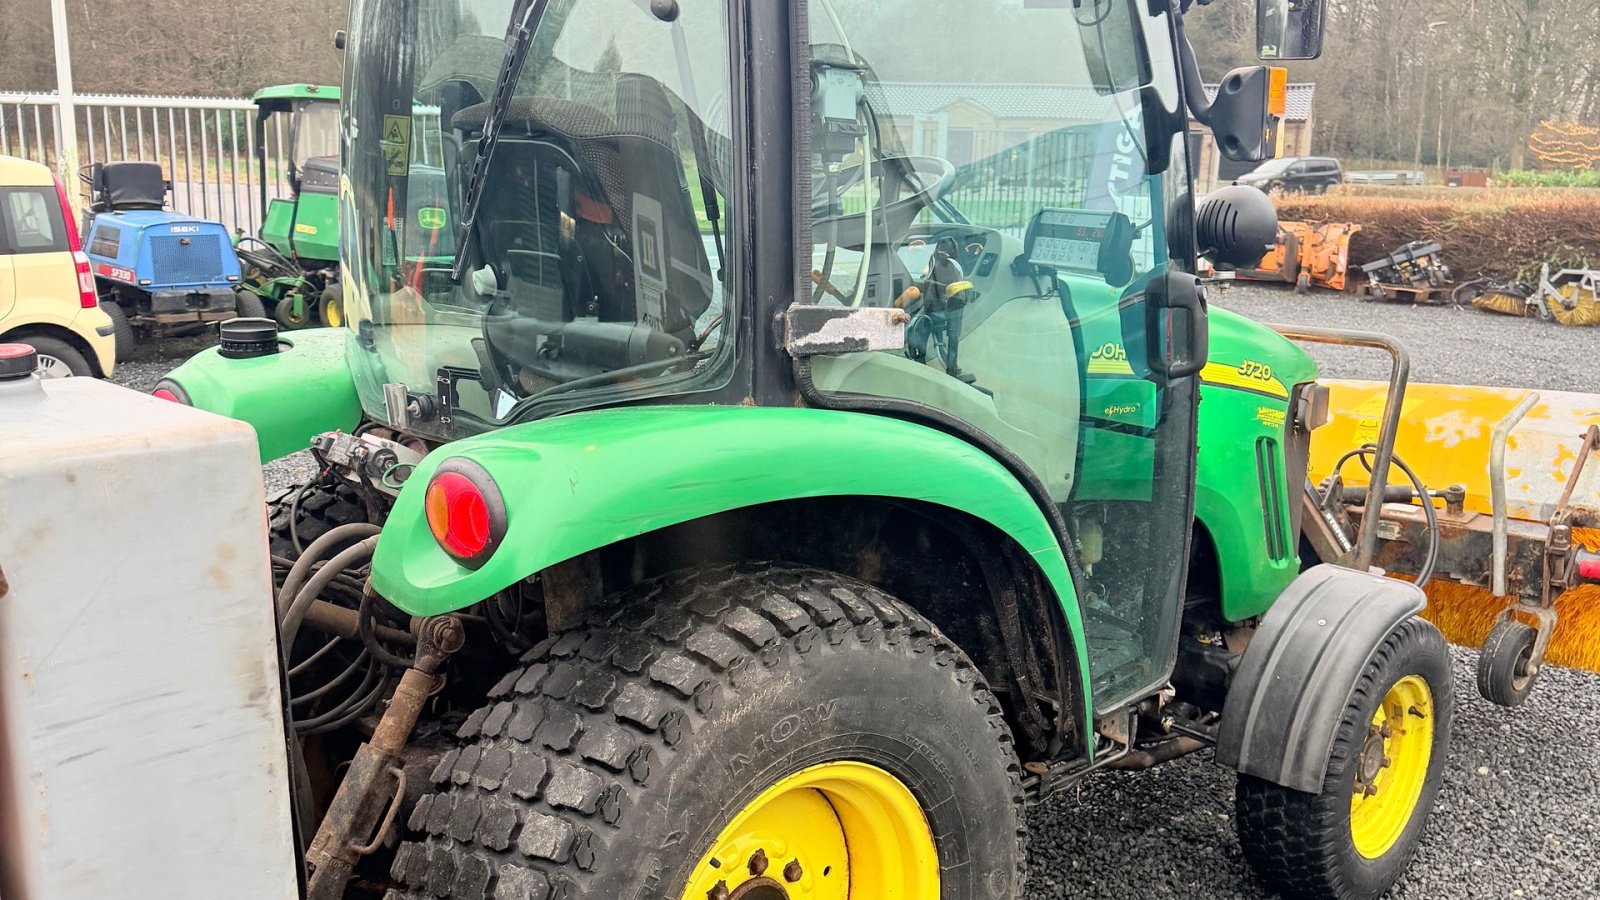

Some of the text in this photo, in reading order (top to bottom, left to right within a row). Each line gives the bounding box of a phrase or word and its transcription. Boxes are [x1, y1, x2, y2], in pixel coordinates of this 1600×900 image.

[170, 225, 200, 233] ISEKI
[110, 267, 131, 281] SF330
[1091, 341, 1126, 360] JOH
[1237, 359, 1272, 381] 3720
[728, 698, 839, 776] MOW
